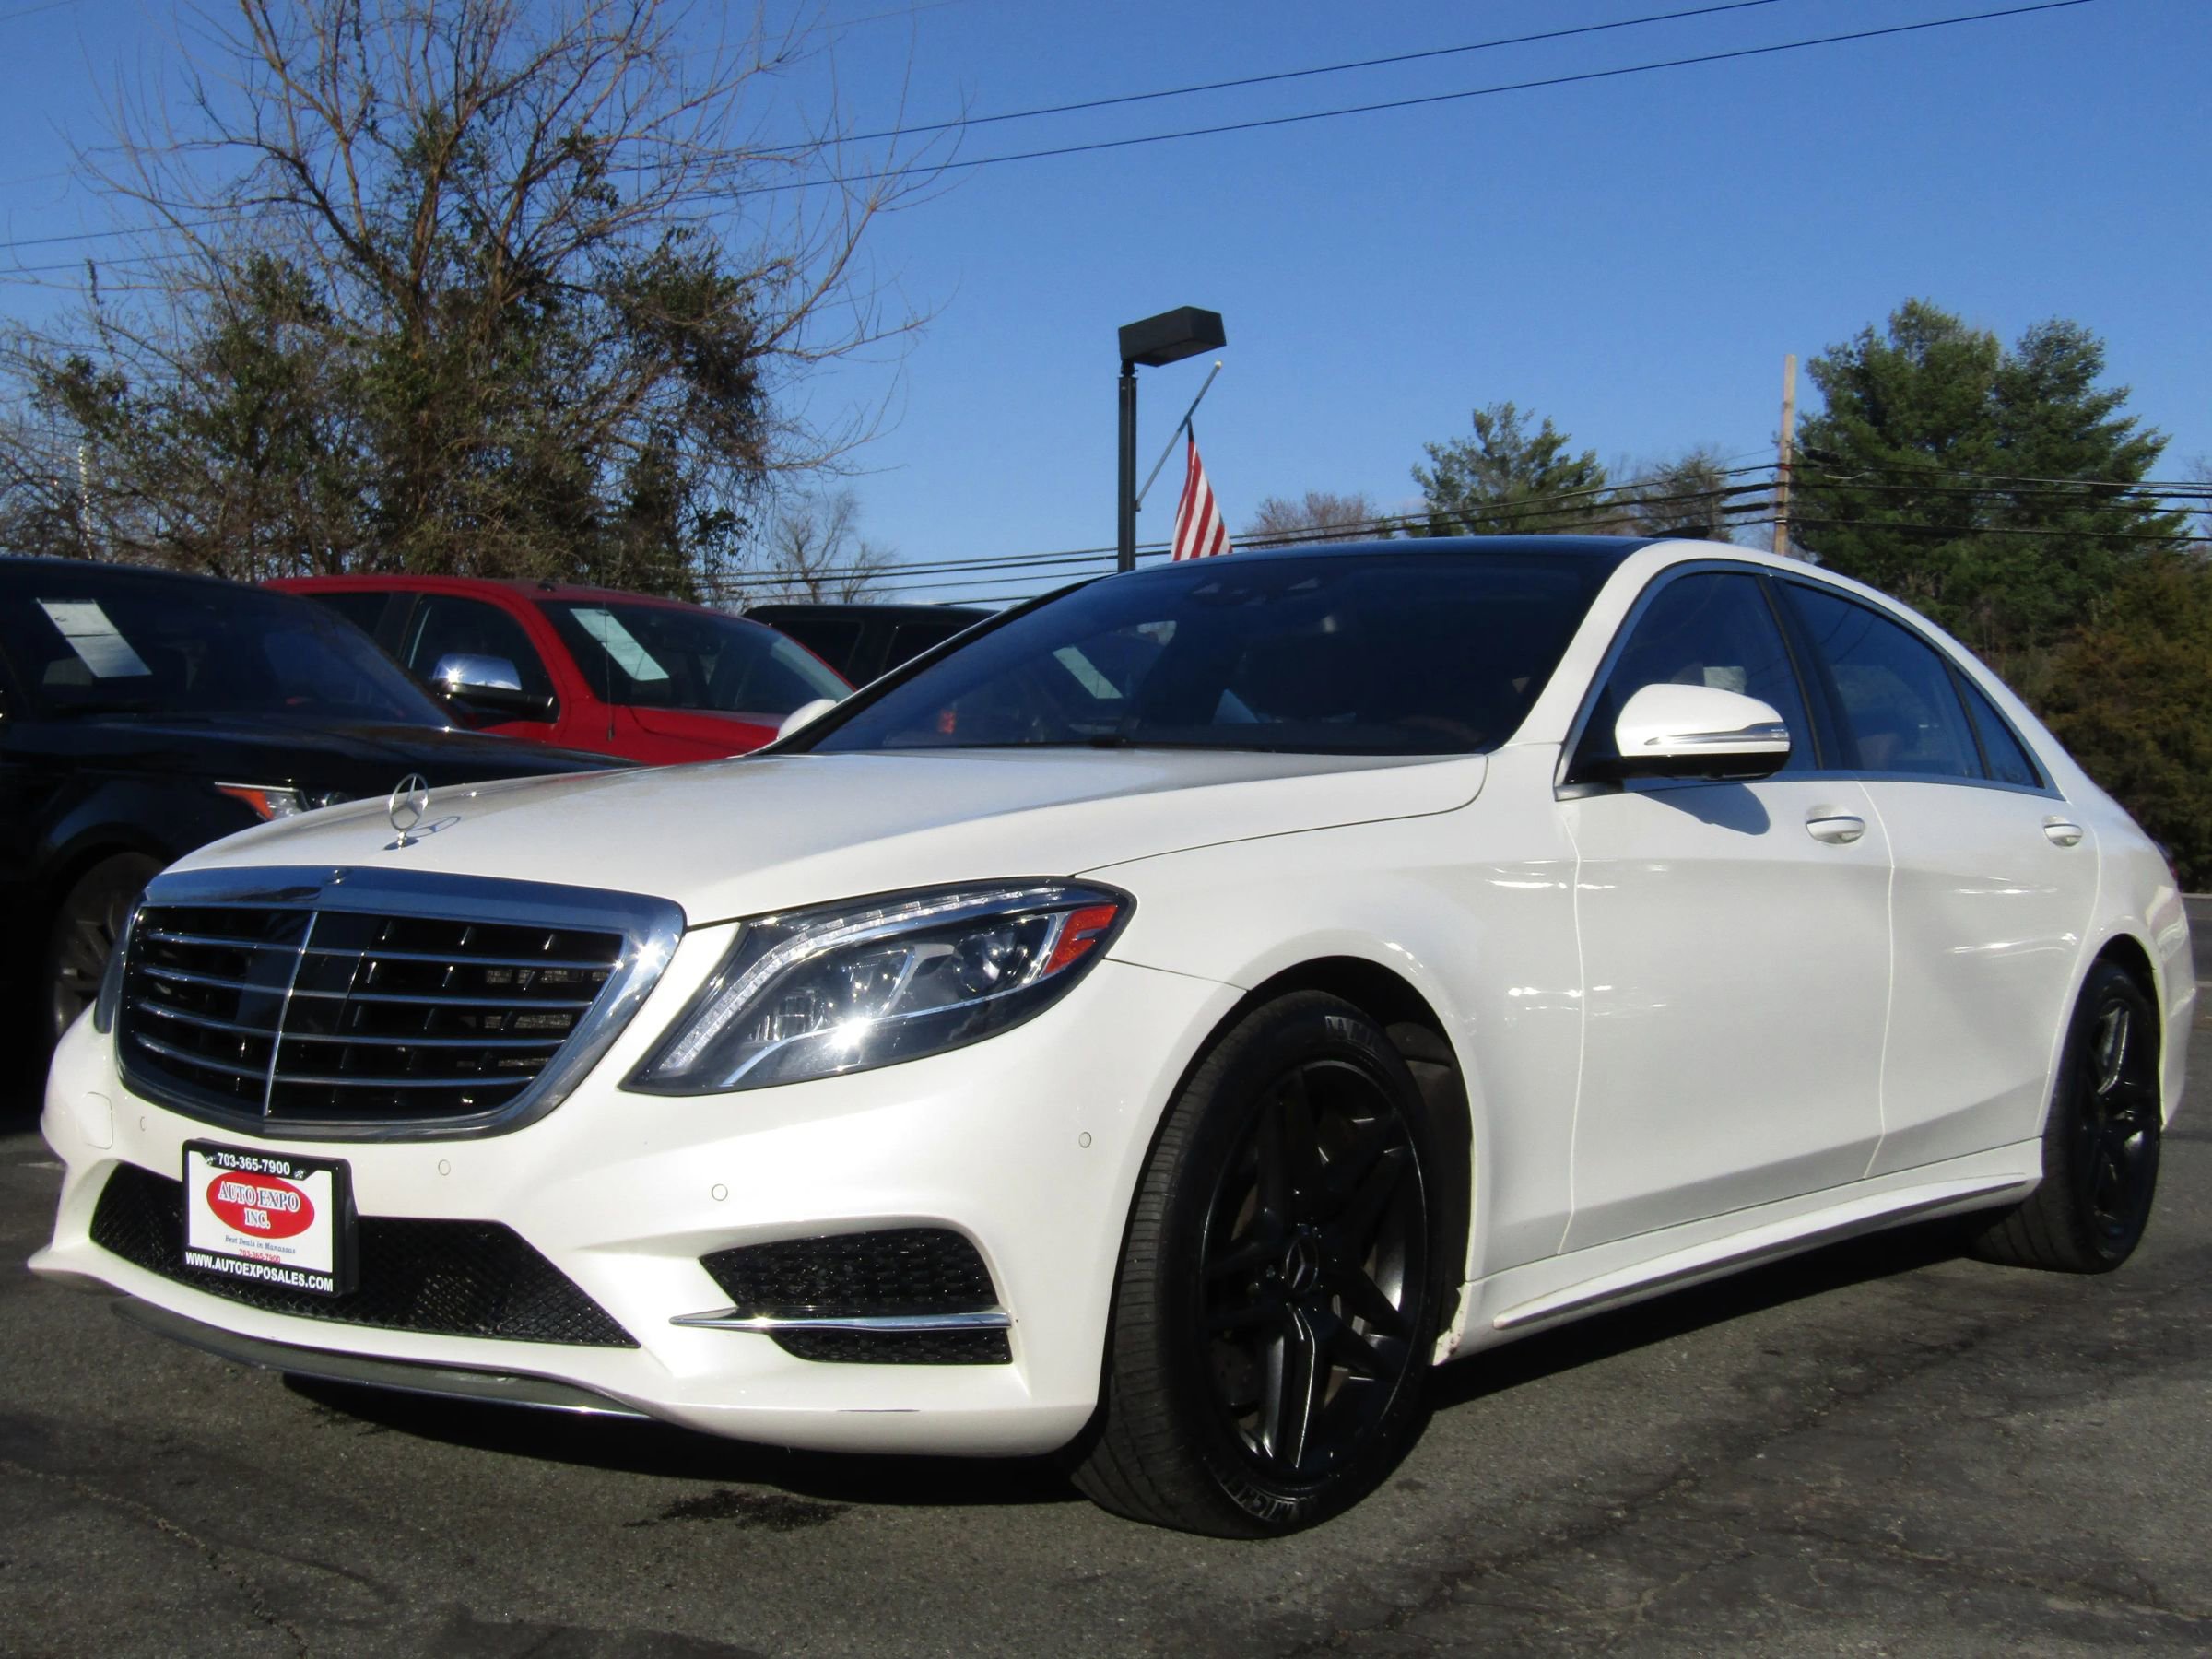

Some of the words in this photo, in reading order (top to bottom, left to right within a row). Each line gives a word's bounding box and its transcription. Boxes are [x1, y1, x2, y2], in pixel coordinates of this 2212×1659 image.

[218, 1152, 290, 1175] 703-365-7900
[219, 1182, 256, 1205] AUTO
[259, 1189, 300, 1211] EXPO
[245, 1209, 270, 1228] INC.
[225, 1235, 238, 1243] Best
[239, 1238, 254, 1247] Deals
[256, 1241, 264, 1249] in
[265, 1242, 296, 1253] Manassas
[239, 1249, 281, 1264] 703-365-7900
[185, 1252, 334, 1292] WWW.AUTOEXPOSALES.COM
